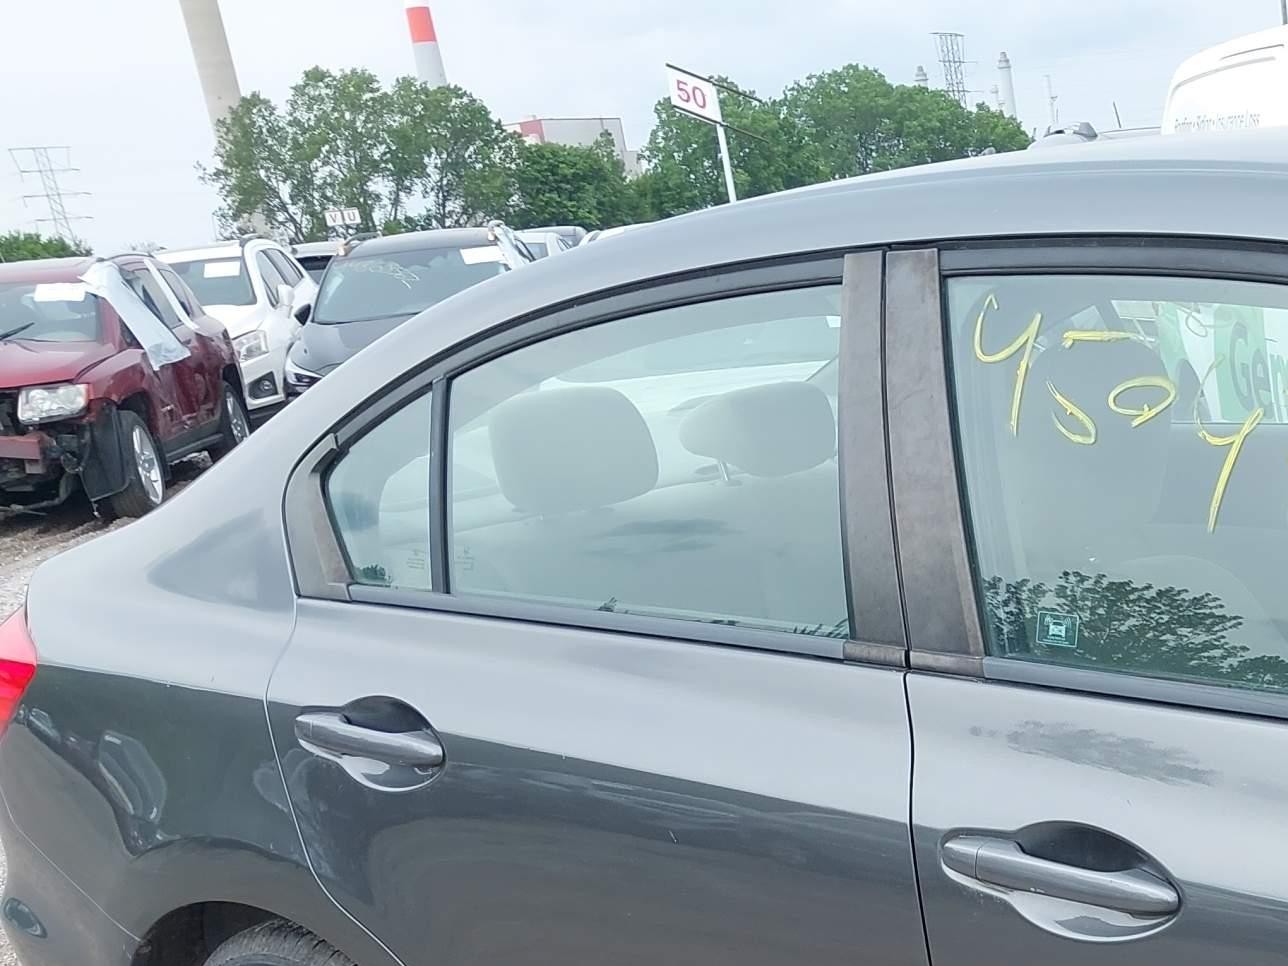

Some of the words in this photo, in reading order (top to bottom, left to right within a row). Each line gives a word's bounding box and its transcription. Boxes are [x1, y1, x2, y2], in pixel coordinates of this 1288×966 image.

[676, 79, 707, 109] 50
[329, 213, 338, 223] V
[348, 211, 357, 221] U
